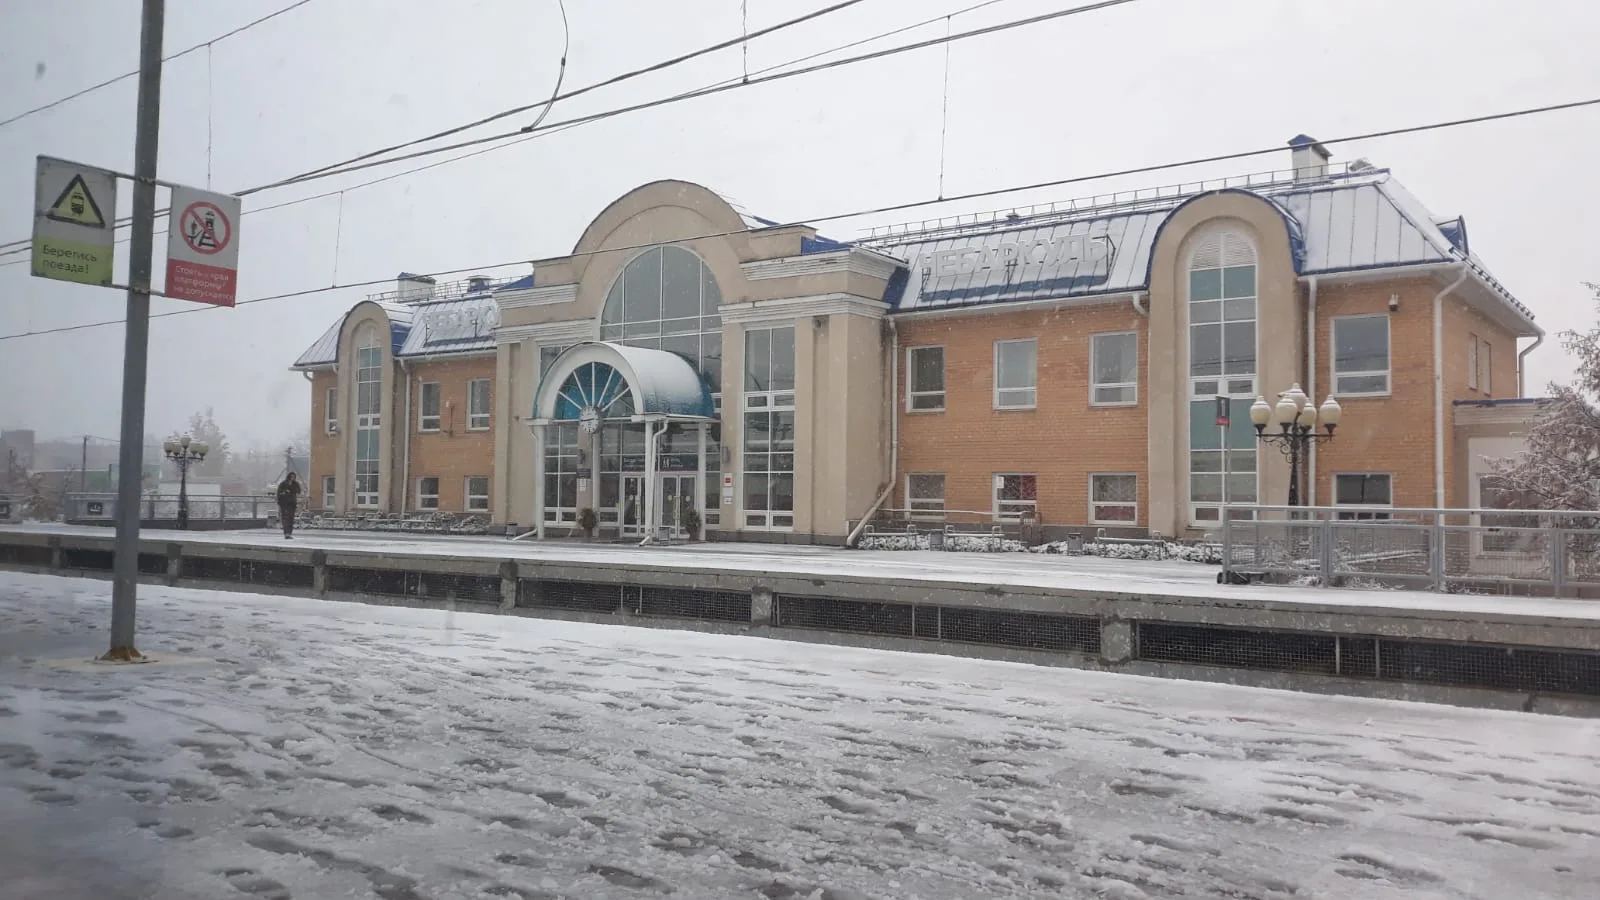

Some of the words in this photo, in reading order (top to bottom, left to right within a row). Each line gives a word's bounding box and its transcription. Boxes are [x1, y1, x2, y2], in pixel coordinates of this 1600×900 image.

[43, 244, 97, 262] Берегись
[919, 234, 1107, 279] ЧЕБАРКУЛЬ
[43, 259, 89, 274] поезда!
